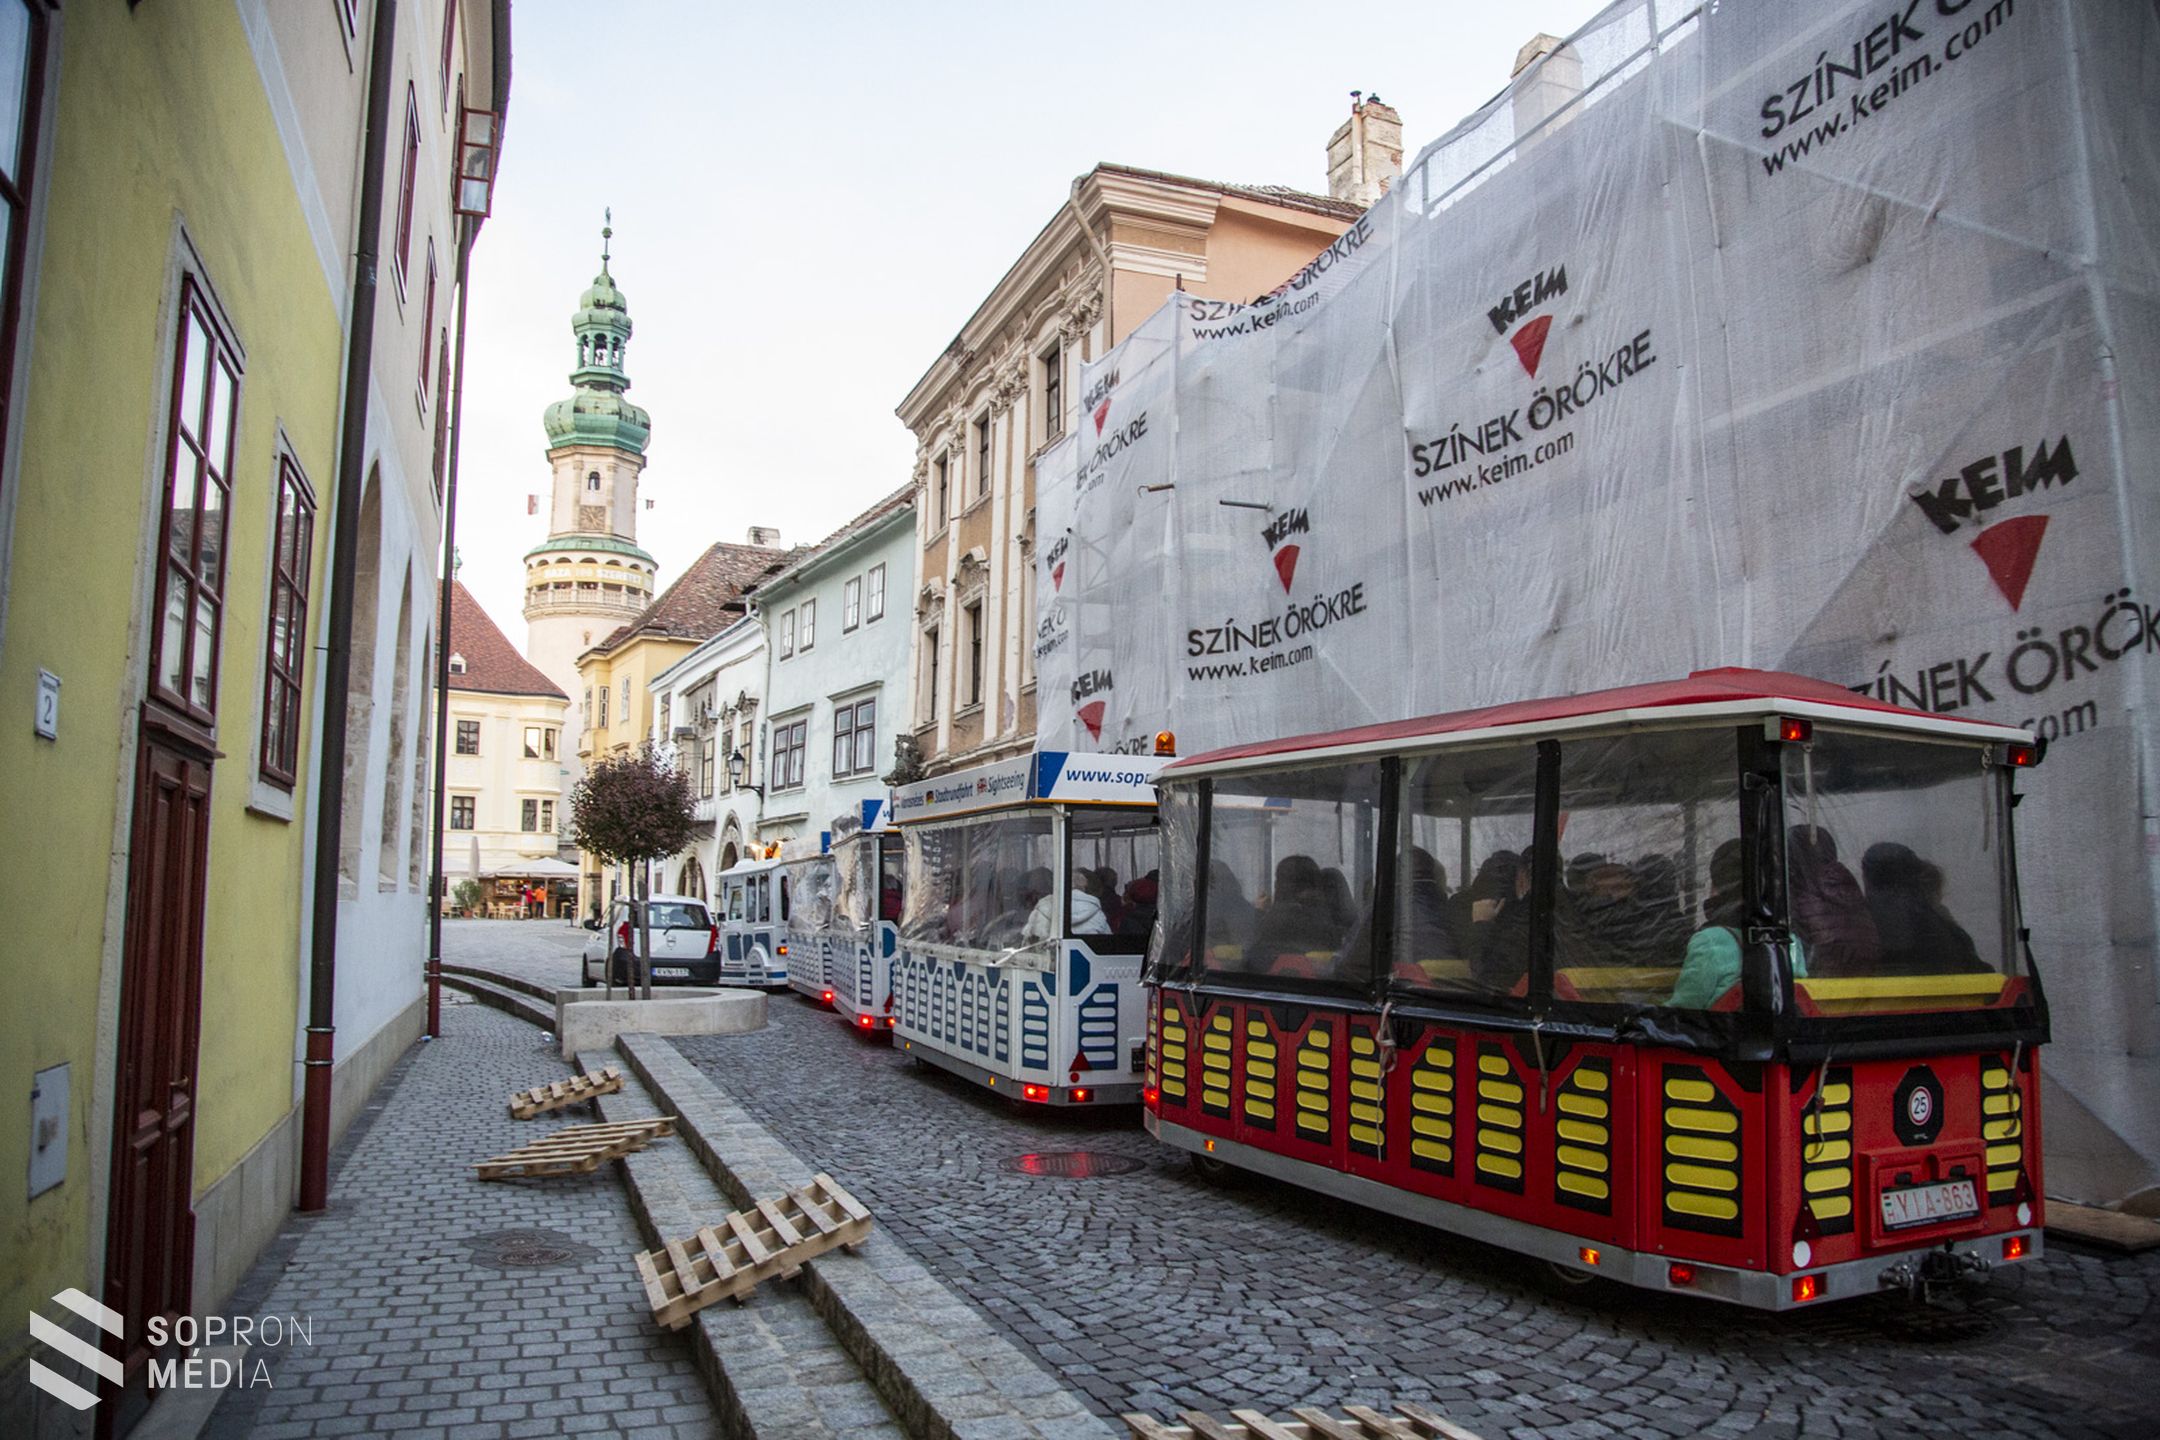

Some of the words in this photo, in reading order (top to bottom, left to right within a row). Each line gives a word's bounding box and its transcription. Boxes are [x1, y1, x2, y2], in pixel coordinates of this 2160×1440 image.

[1761, 0, 1925, 139] SZÍNEK
[1761, 0, 2014, 177] www.keim.com
[1192, 291, 1320, 340] www.keim.com
[1487, 263, 1568, 336] KEIM
[1412, 408, 1522, 477] SZÍNEK
[1527, 329, 1656, 430] ÖRÖKRE.
[1418, 432, 1574, 506] www.keim.com
[1908, 433, 2079, 535] KEIM
[1261, 508, 1310, 551] KEIM
[1188, 617, 1282, 657] SZÍNEK
[1284, 582, 1367, 638] ÖRÖKRE.
[1848, 651, 1996, 713] ÍNEK
[2006, 587, 2160, 694] ÖRÖK
[1071, 669, 1113, 706] KEIM
[1188, 645, 1312, 680] www.keim.com
[44, 695, 52, 725] 2
[987, 770, 1026, 796] Sightseeing
[1913, 1096, 1928, 1115] 25
[1896, 1183, 1974, 1219] YIA-863
